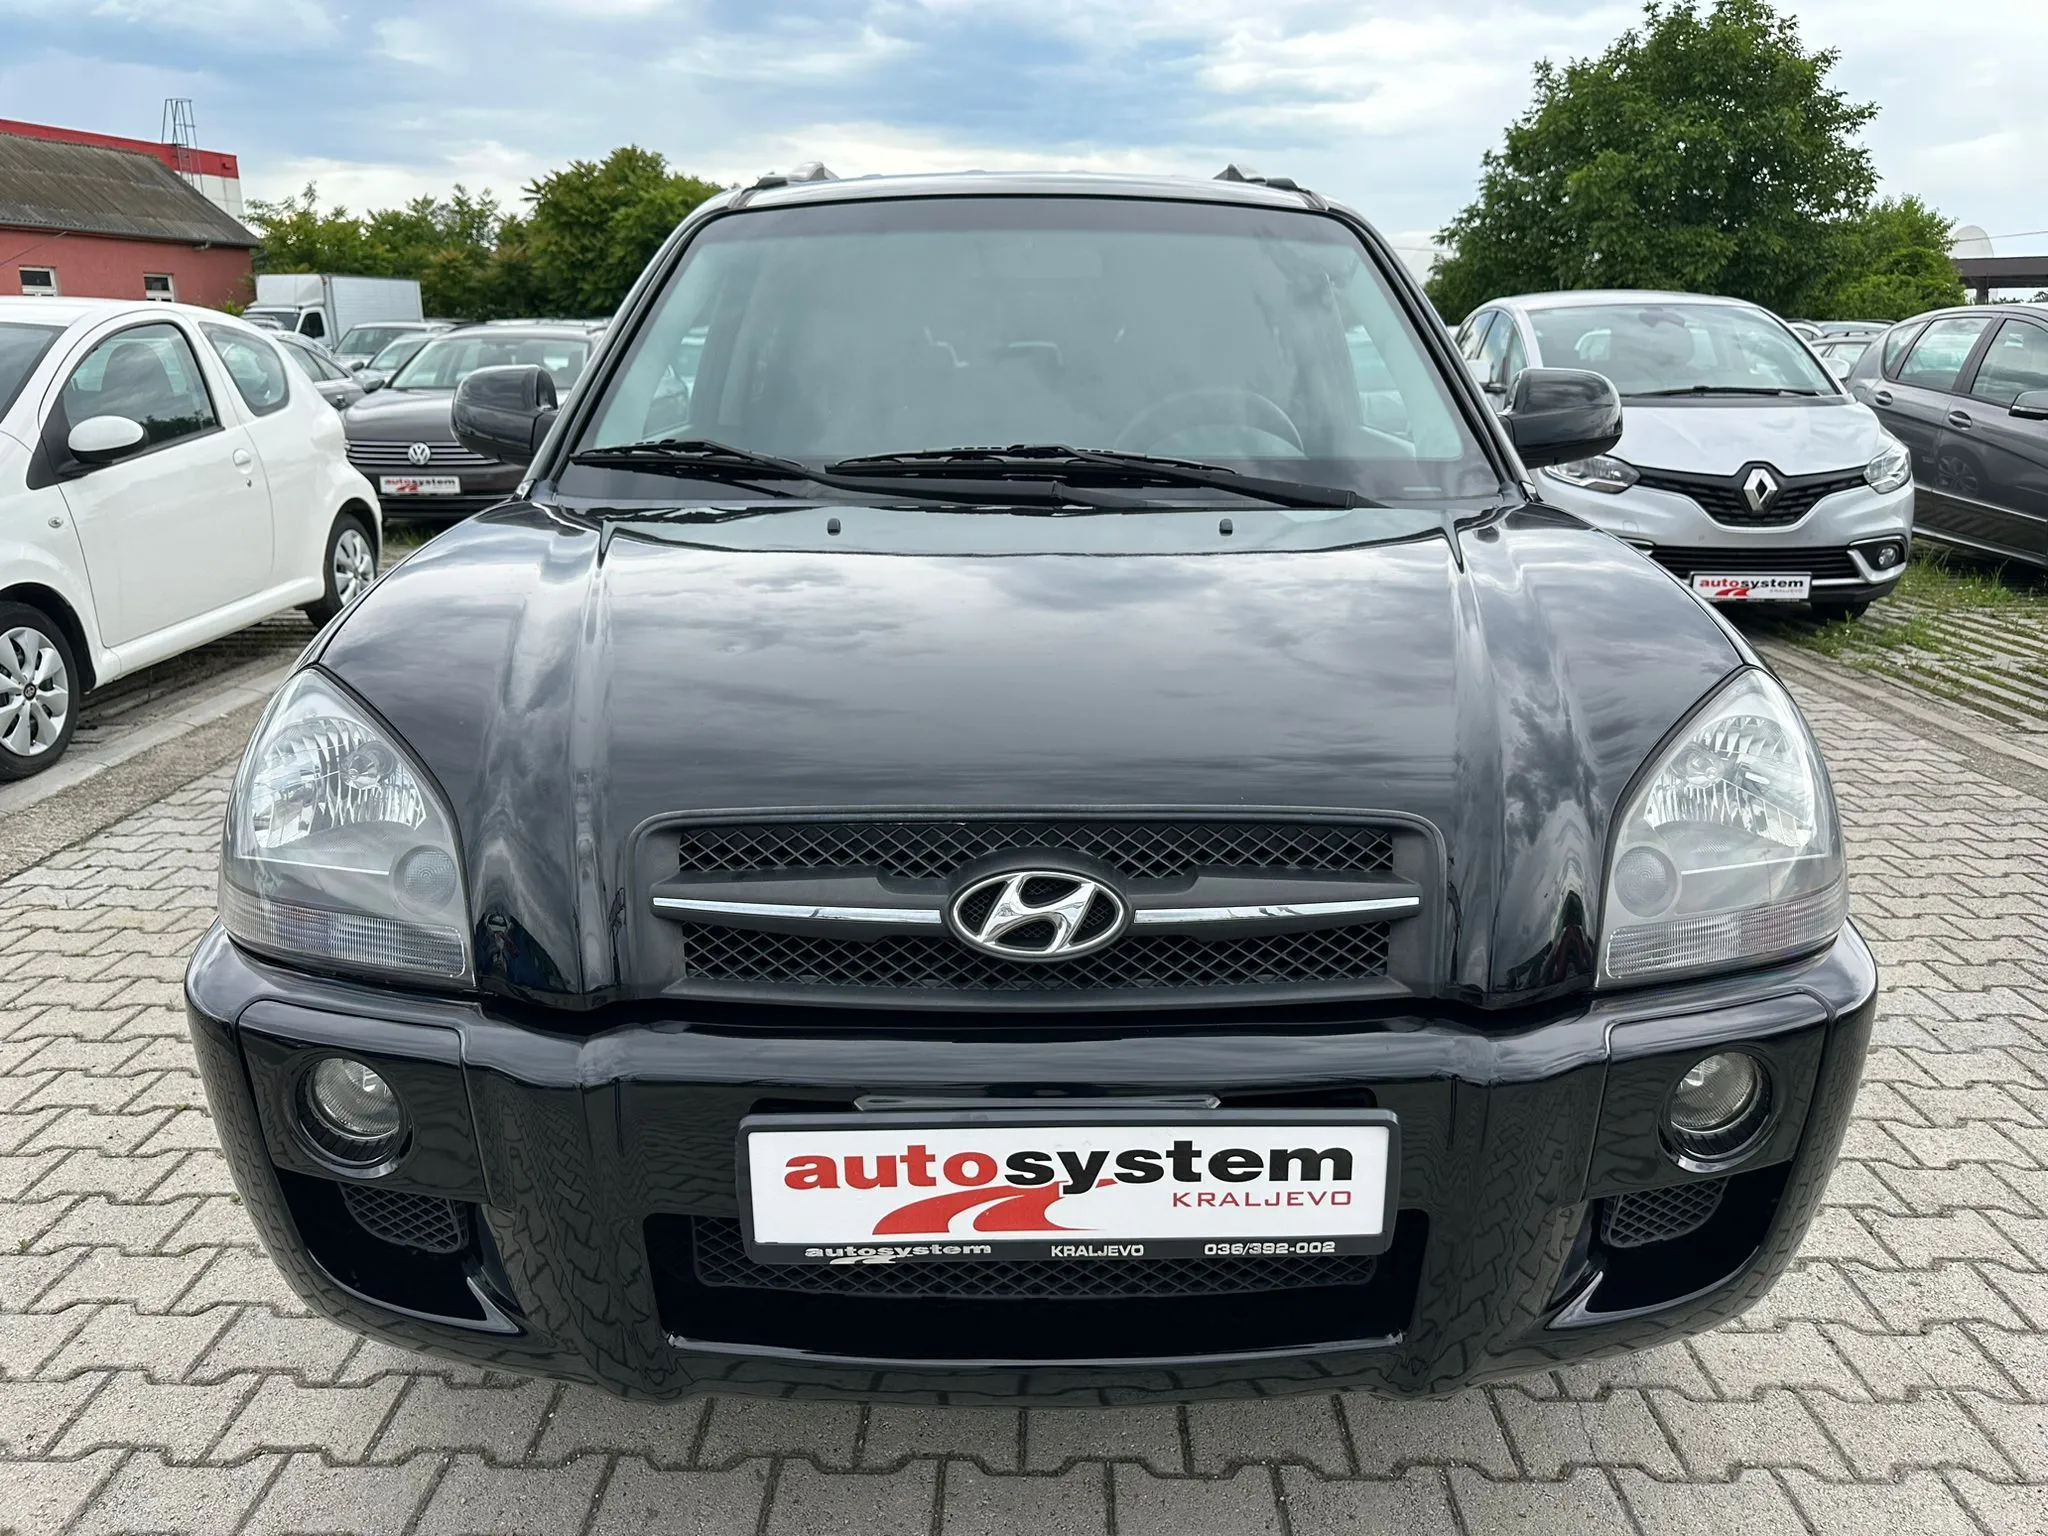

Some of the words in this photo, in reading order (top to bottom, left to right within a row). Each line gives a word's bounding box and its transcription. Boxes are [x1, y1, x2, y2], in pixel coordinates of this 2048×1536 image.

[1699, 578, 1803, 588] autosystem
[784, 1140, 1353, 1195] autosystem
[1172, 1190, 1352, 1208] KRALJEVO
[804, 1243, 992, 1258] autosystem
[1050, 1244, 1144, 1257] KRALJEVO
[1203, 1241, 1336, 1256] 036/392-002
